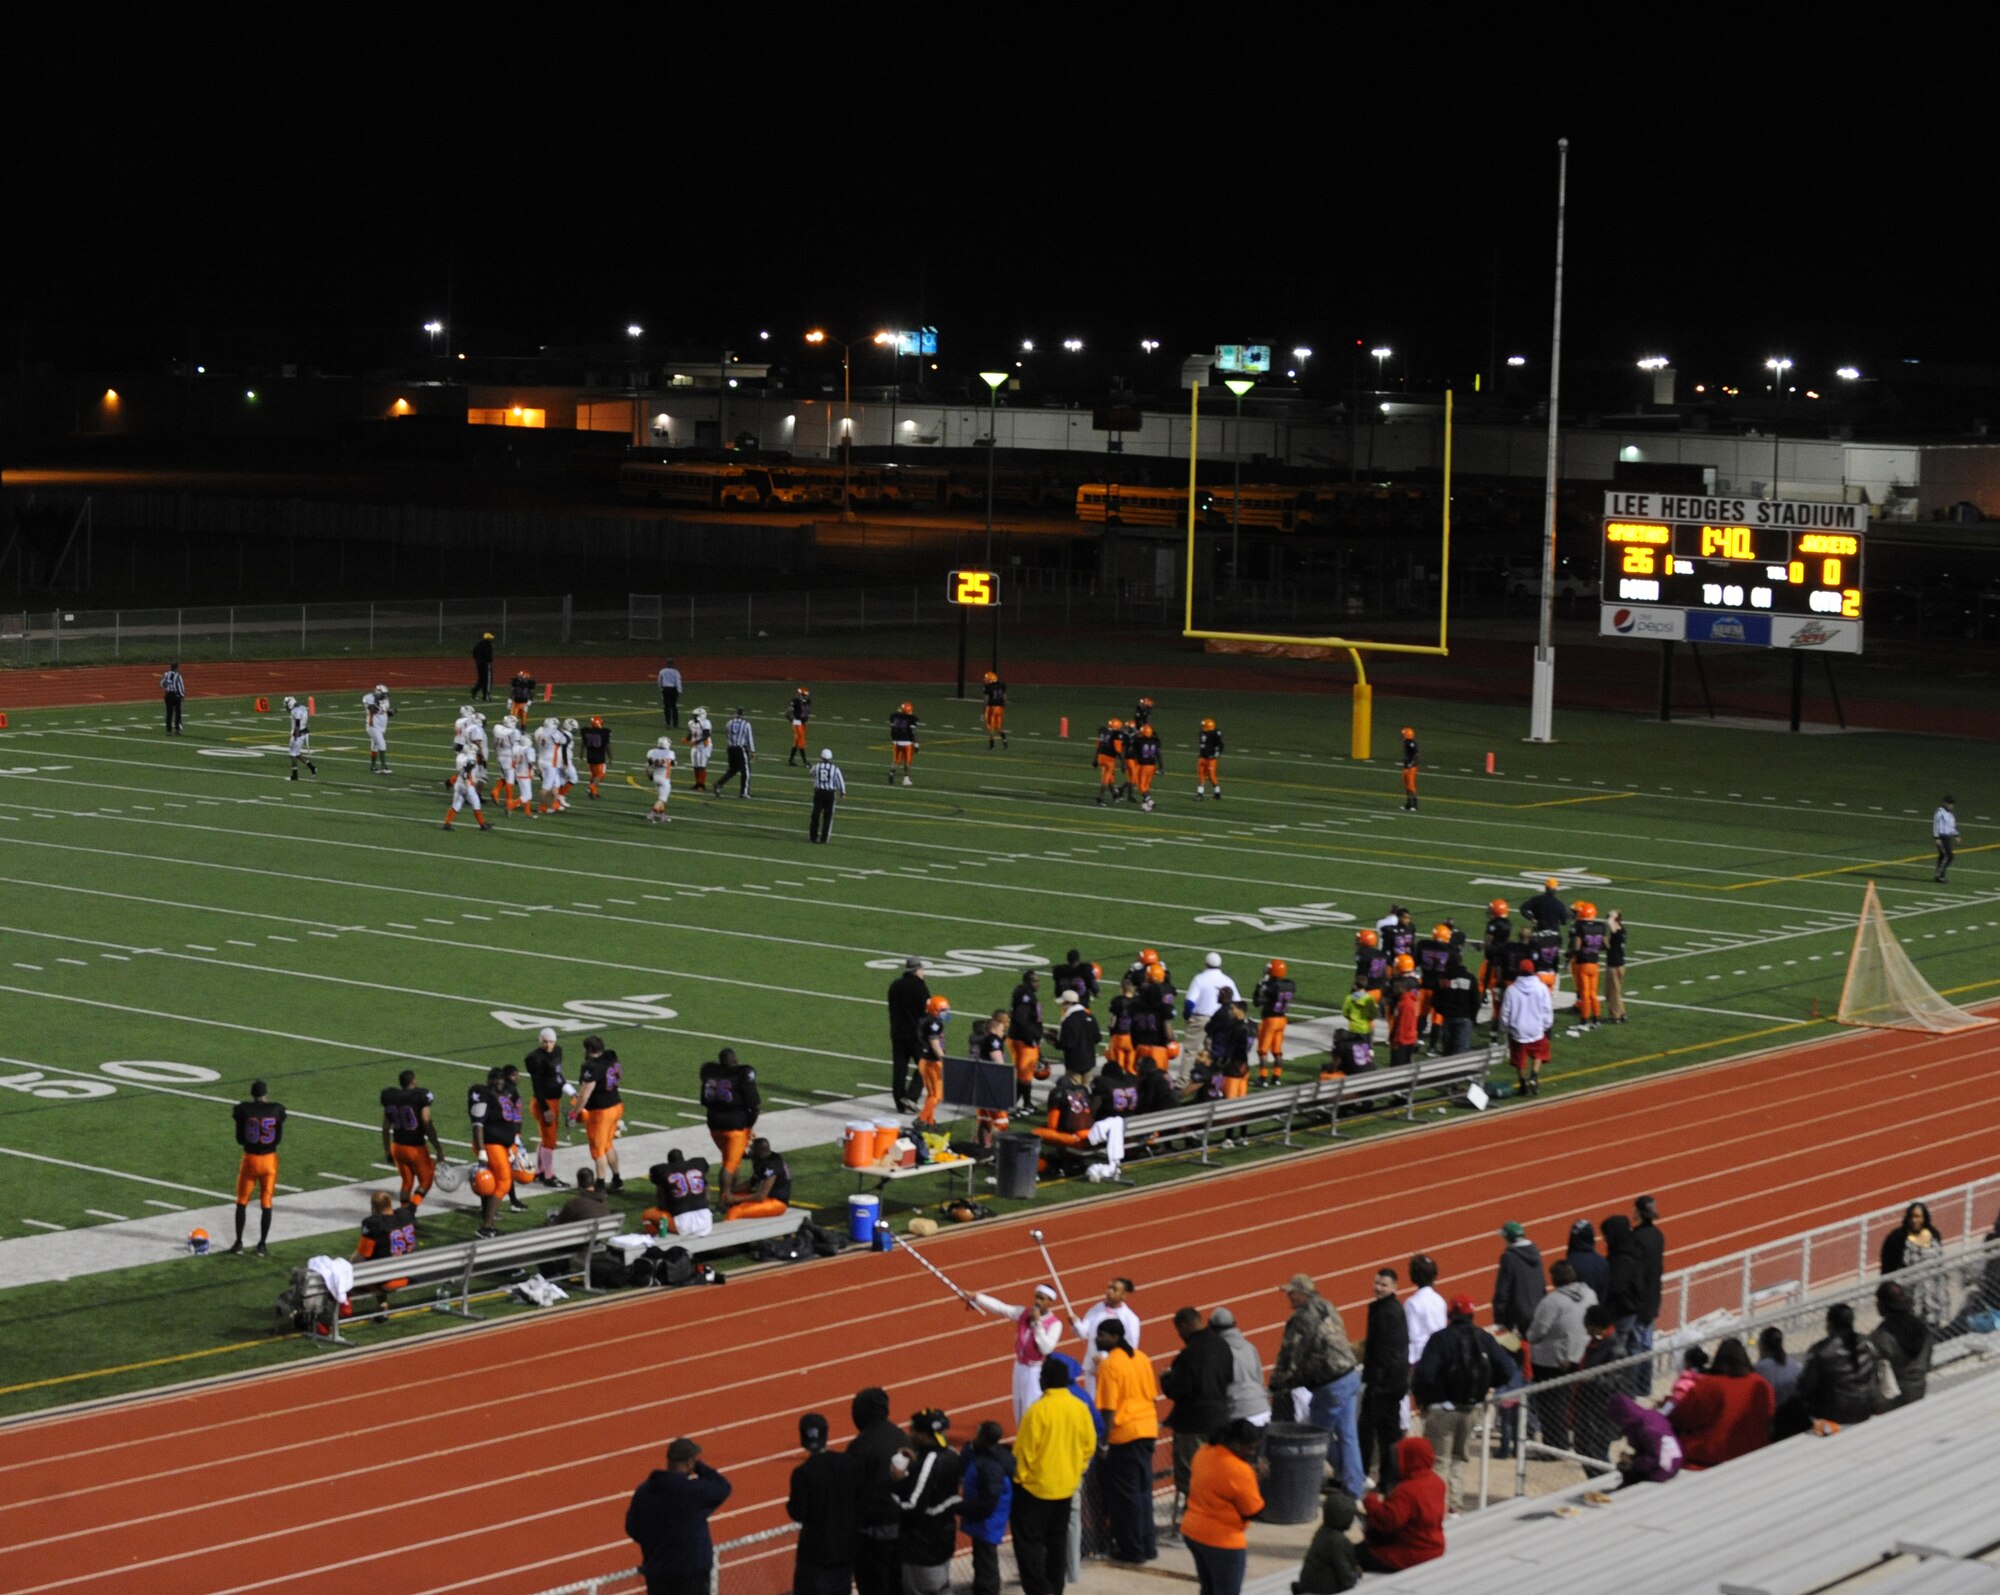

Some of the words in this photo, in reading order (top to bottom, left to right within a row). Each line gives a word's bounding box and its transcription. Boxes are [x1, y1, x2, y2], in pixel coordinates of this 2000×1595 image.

[1613, 494, 1649, 516] LEE
[1661, 497, 1745, 522] HEDGES
[1757, 502, 1855, 528] STADIUM
[1823, 559, 1841, 585] 0
[958, 572, 989, 604] 25
[1842, 589, 1860, 616] 2
[819, 769, 831, 783] R
[1193, 906, 1357, 932] 20
[864, 949, 1051, 978] 30
[489, 1000, 679, 1032] 40
[0, 1060, 222, 1099] 50
[667, 1168, 704, 1198] 36
[389, 1224, 416, 1257] 65
